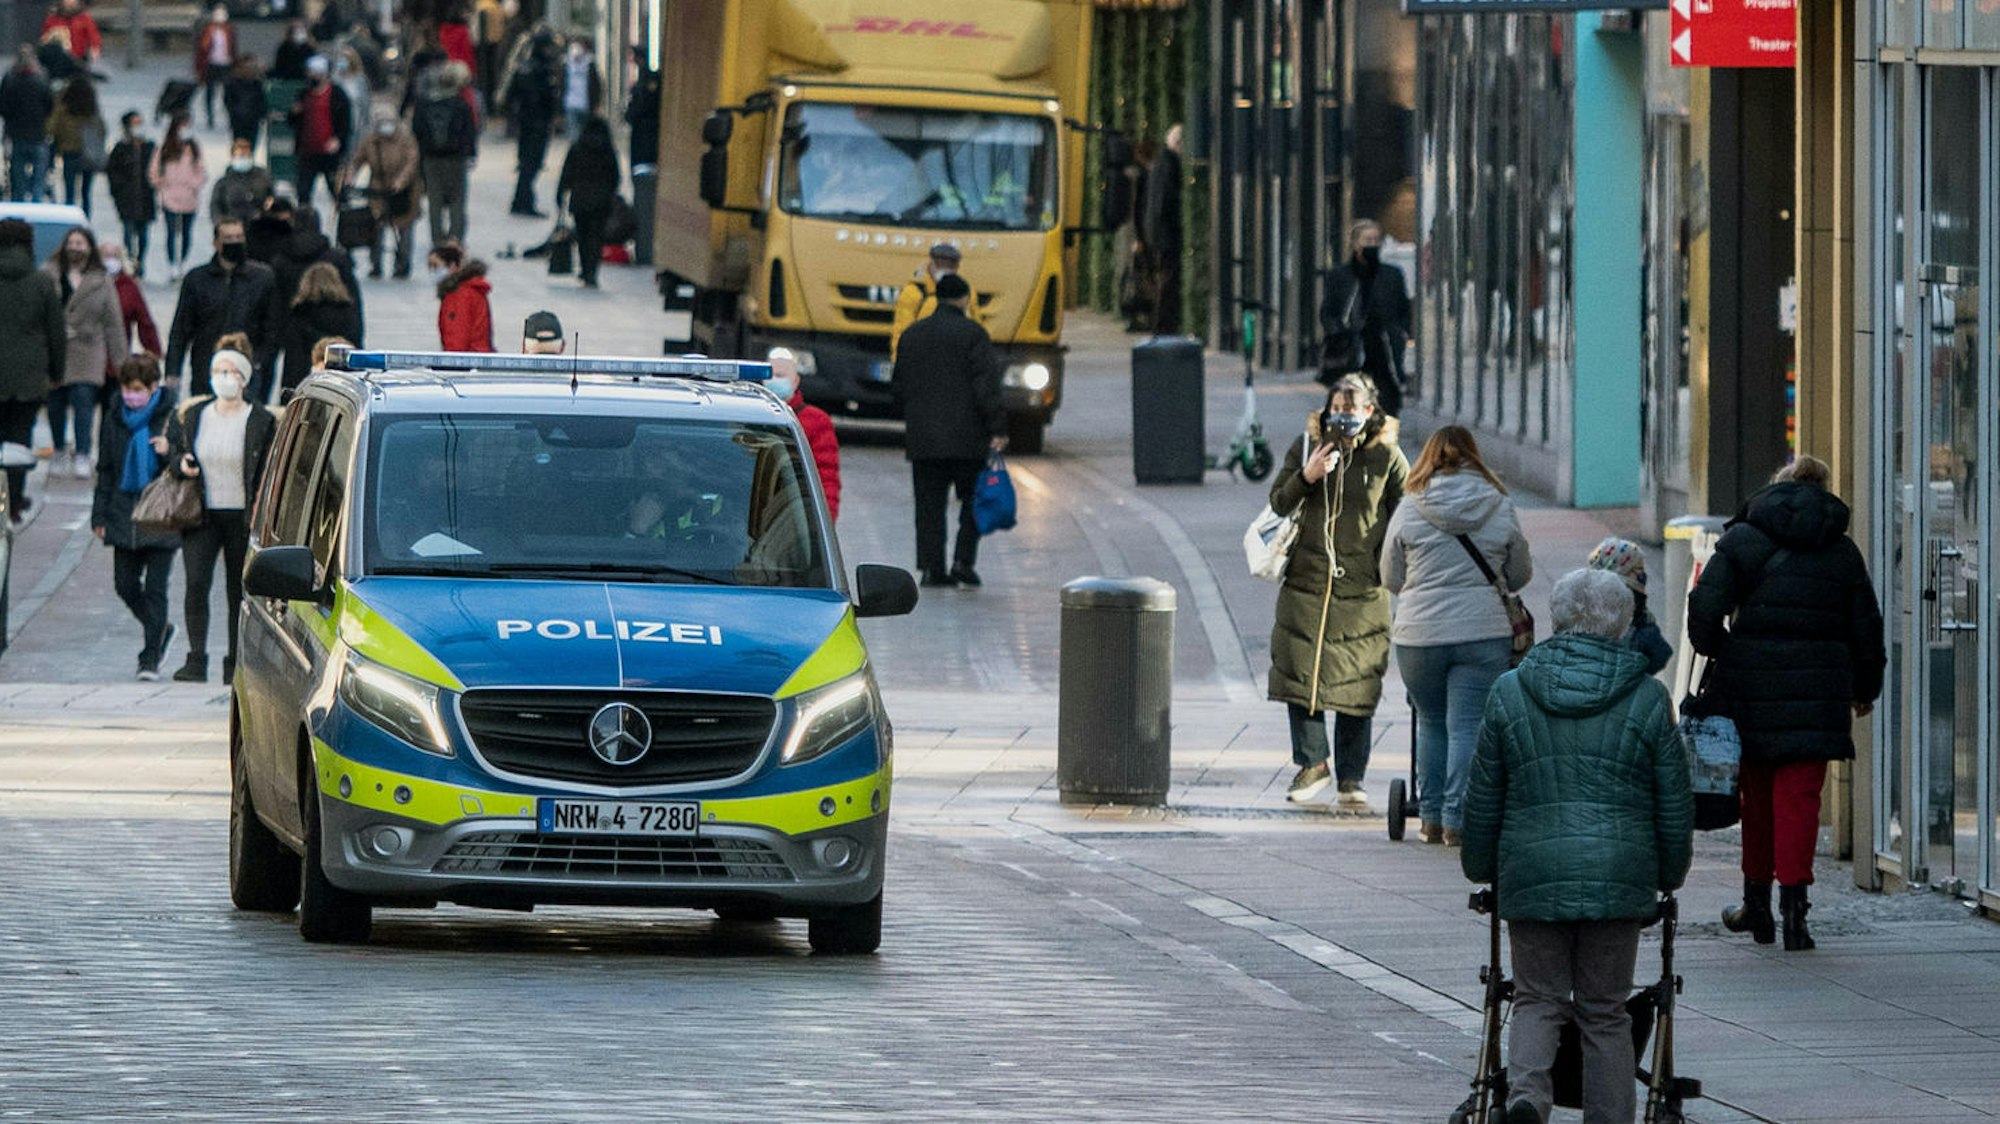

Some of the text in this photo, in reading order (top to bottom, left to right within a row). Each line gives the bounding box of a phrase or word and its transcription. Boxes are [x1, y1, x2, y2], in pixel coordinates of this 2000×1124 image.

[853, 16, 989, 39] DHL
[1748, 36, 1791, 51] Theater
[497, 619, 723, 645] POLIZEI
[554, 803, 696, 831] NRW 4-7280
